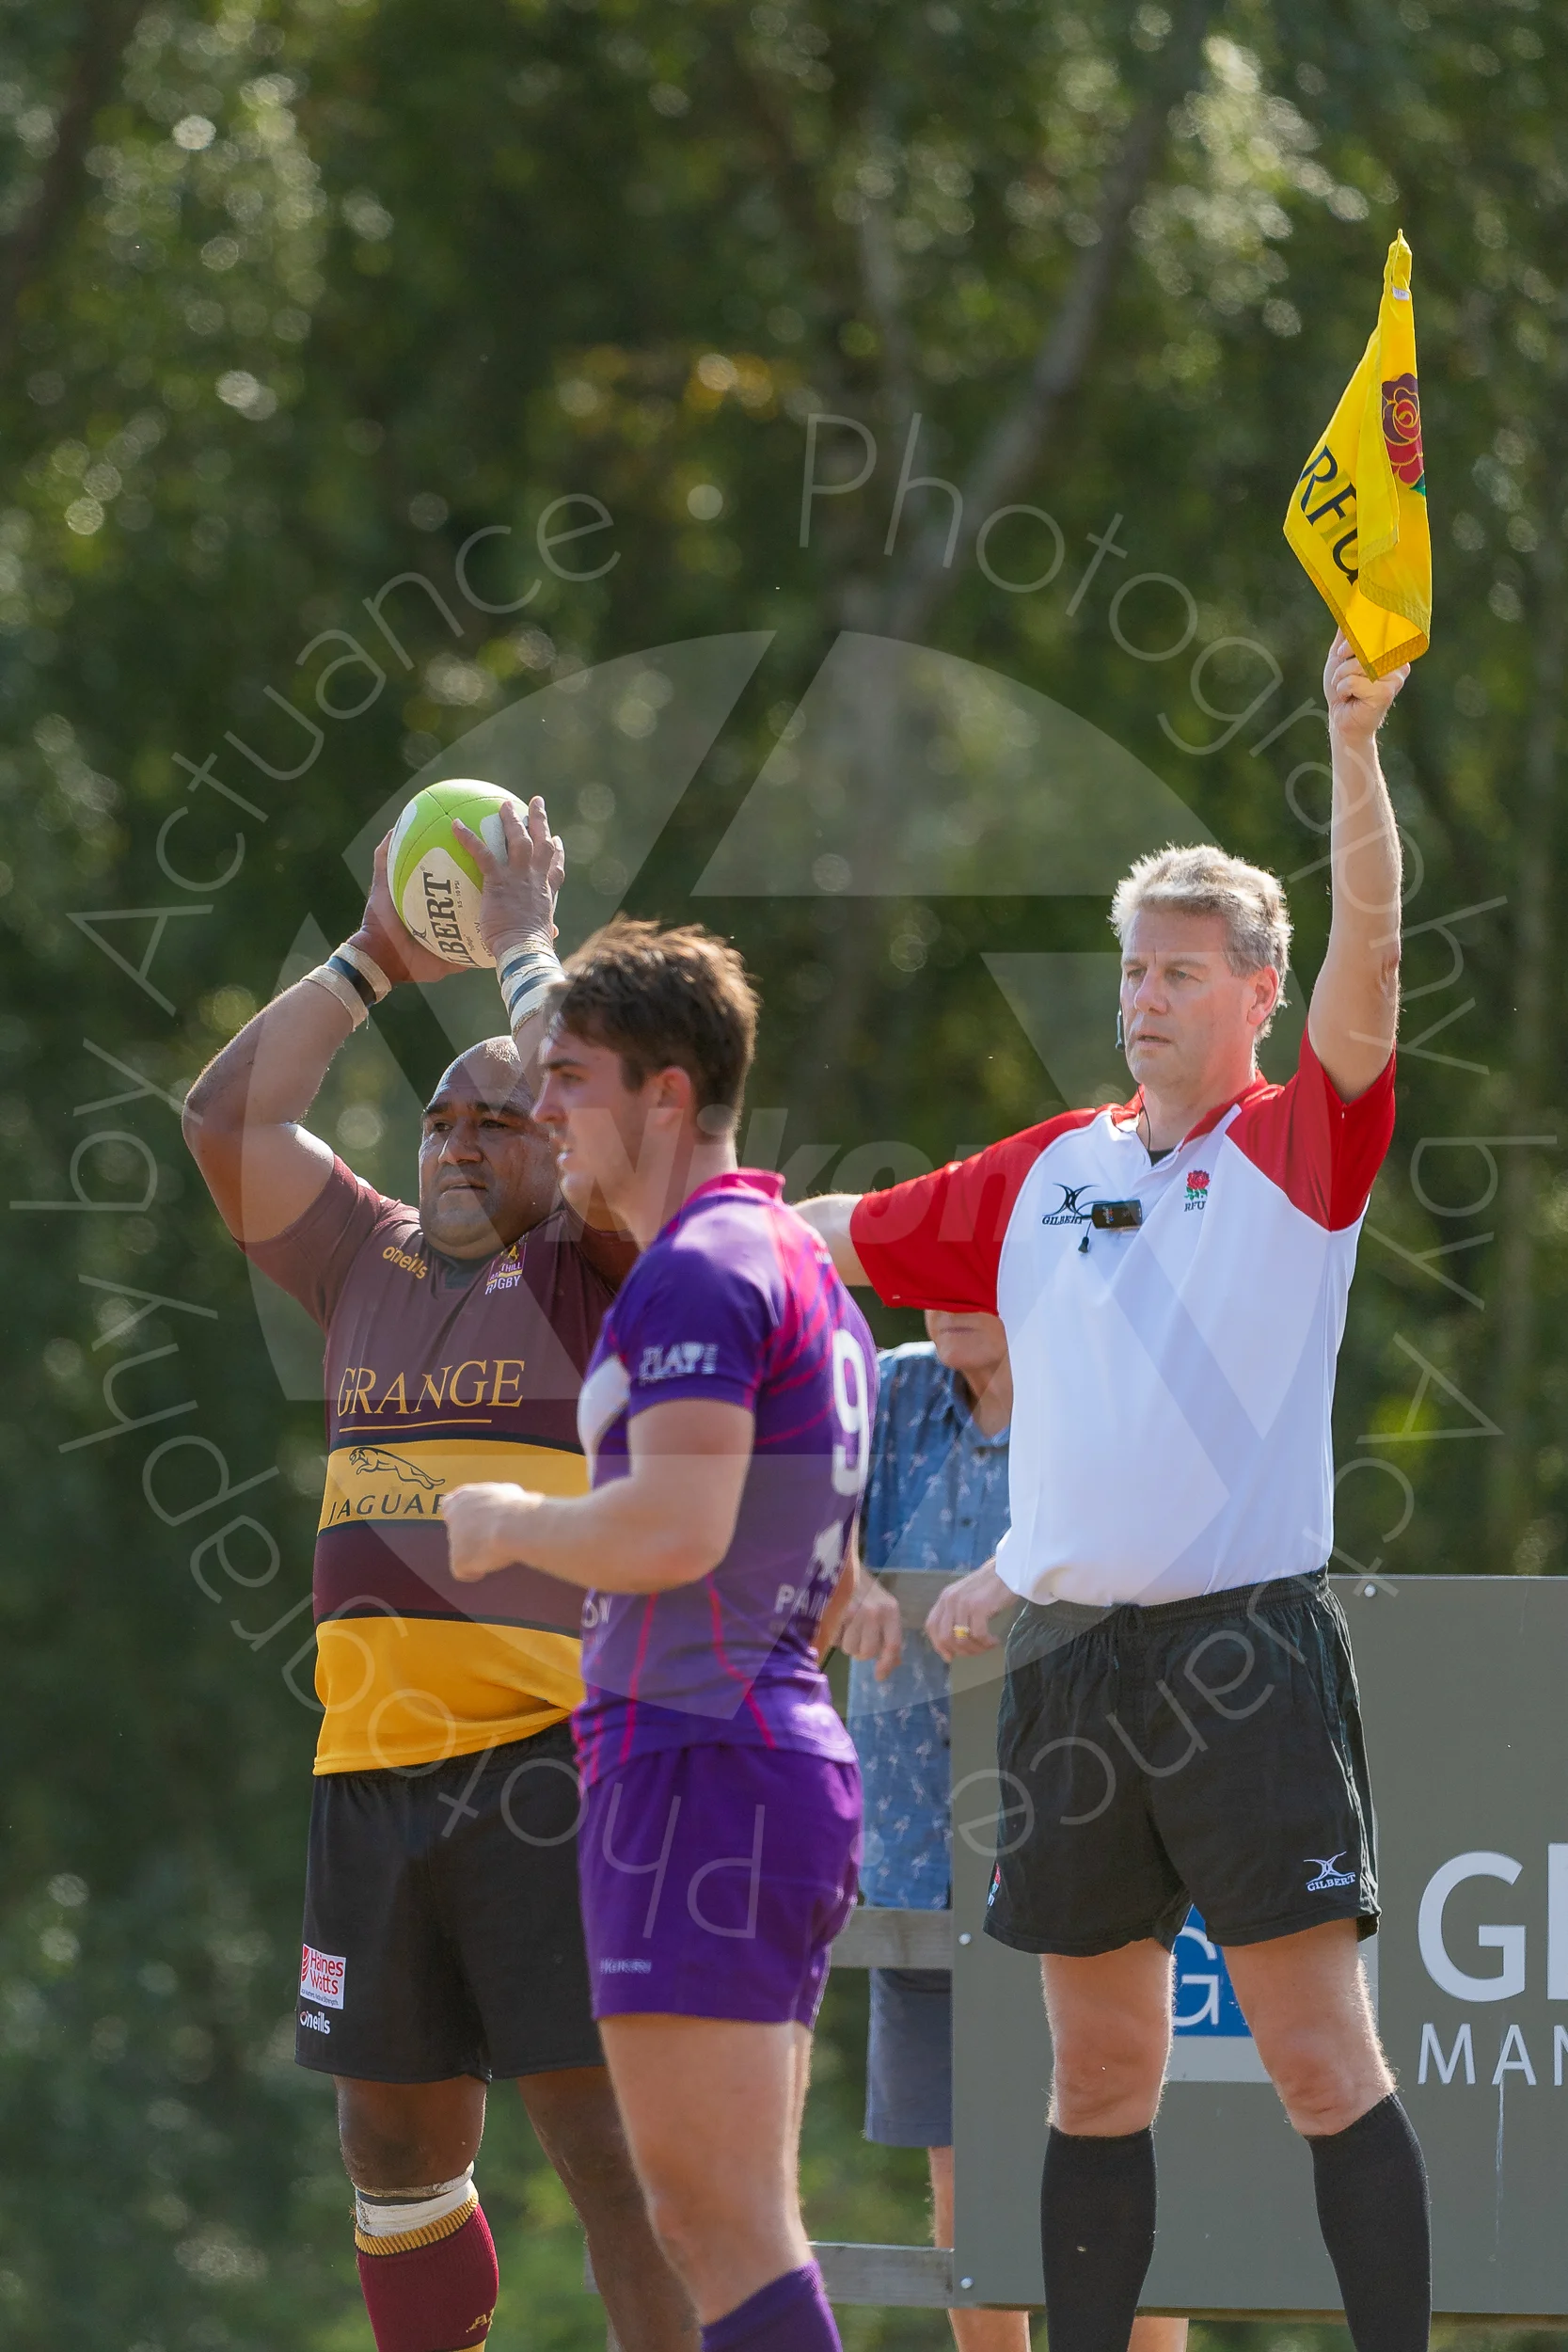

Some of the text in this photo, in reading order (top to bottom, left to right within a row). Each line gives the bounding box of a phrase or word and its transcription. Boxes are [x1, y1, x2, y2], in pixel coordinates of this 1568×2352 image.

[423, 871, 478, 966] LBERT
[1183, 1200, 1207, 1213] RFU
[337, 1359, 526, 1418] GRANGE
[832, 1327, 870, 1497] 9
[1307, 1873, 1356, 1892] GILBERT
[309, 1949, 344, 1978] Haines
[309, 1969, 339, 1994] Watts
